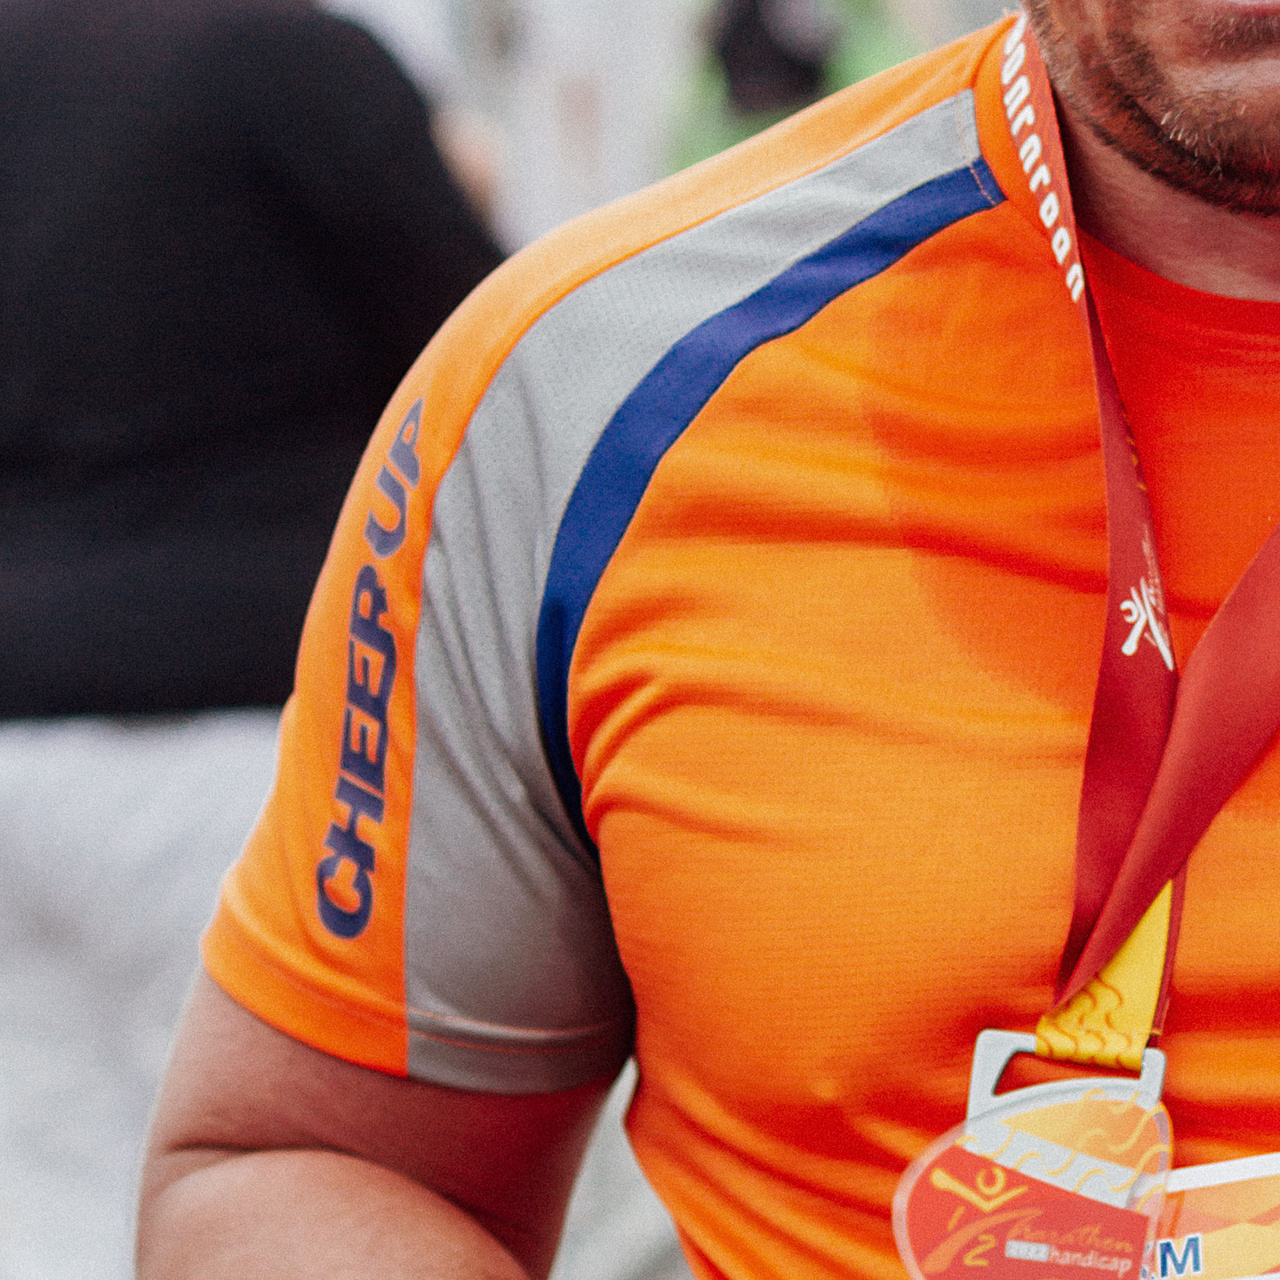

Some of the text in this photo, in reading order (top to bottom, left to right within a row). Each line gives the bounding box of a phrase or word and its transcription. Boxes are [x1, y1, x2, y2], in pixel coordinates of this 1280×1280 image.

[316, 397, 425, 941] CHEER UP
[1050, 1246, 1133, 1278] handicap
